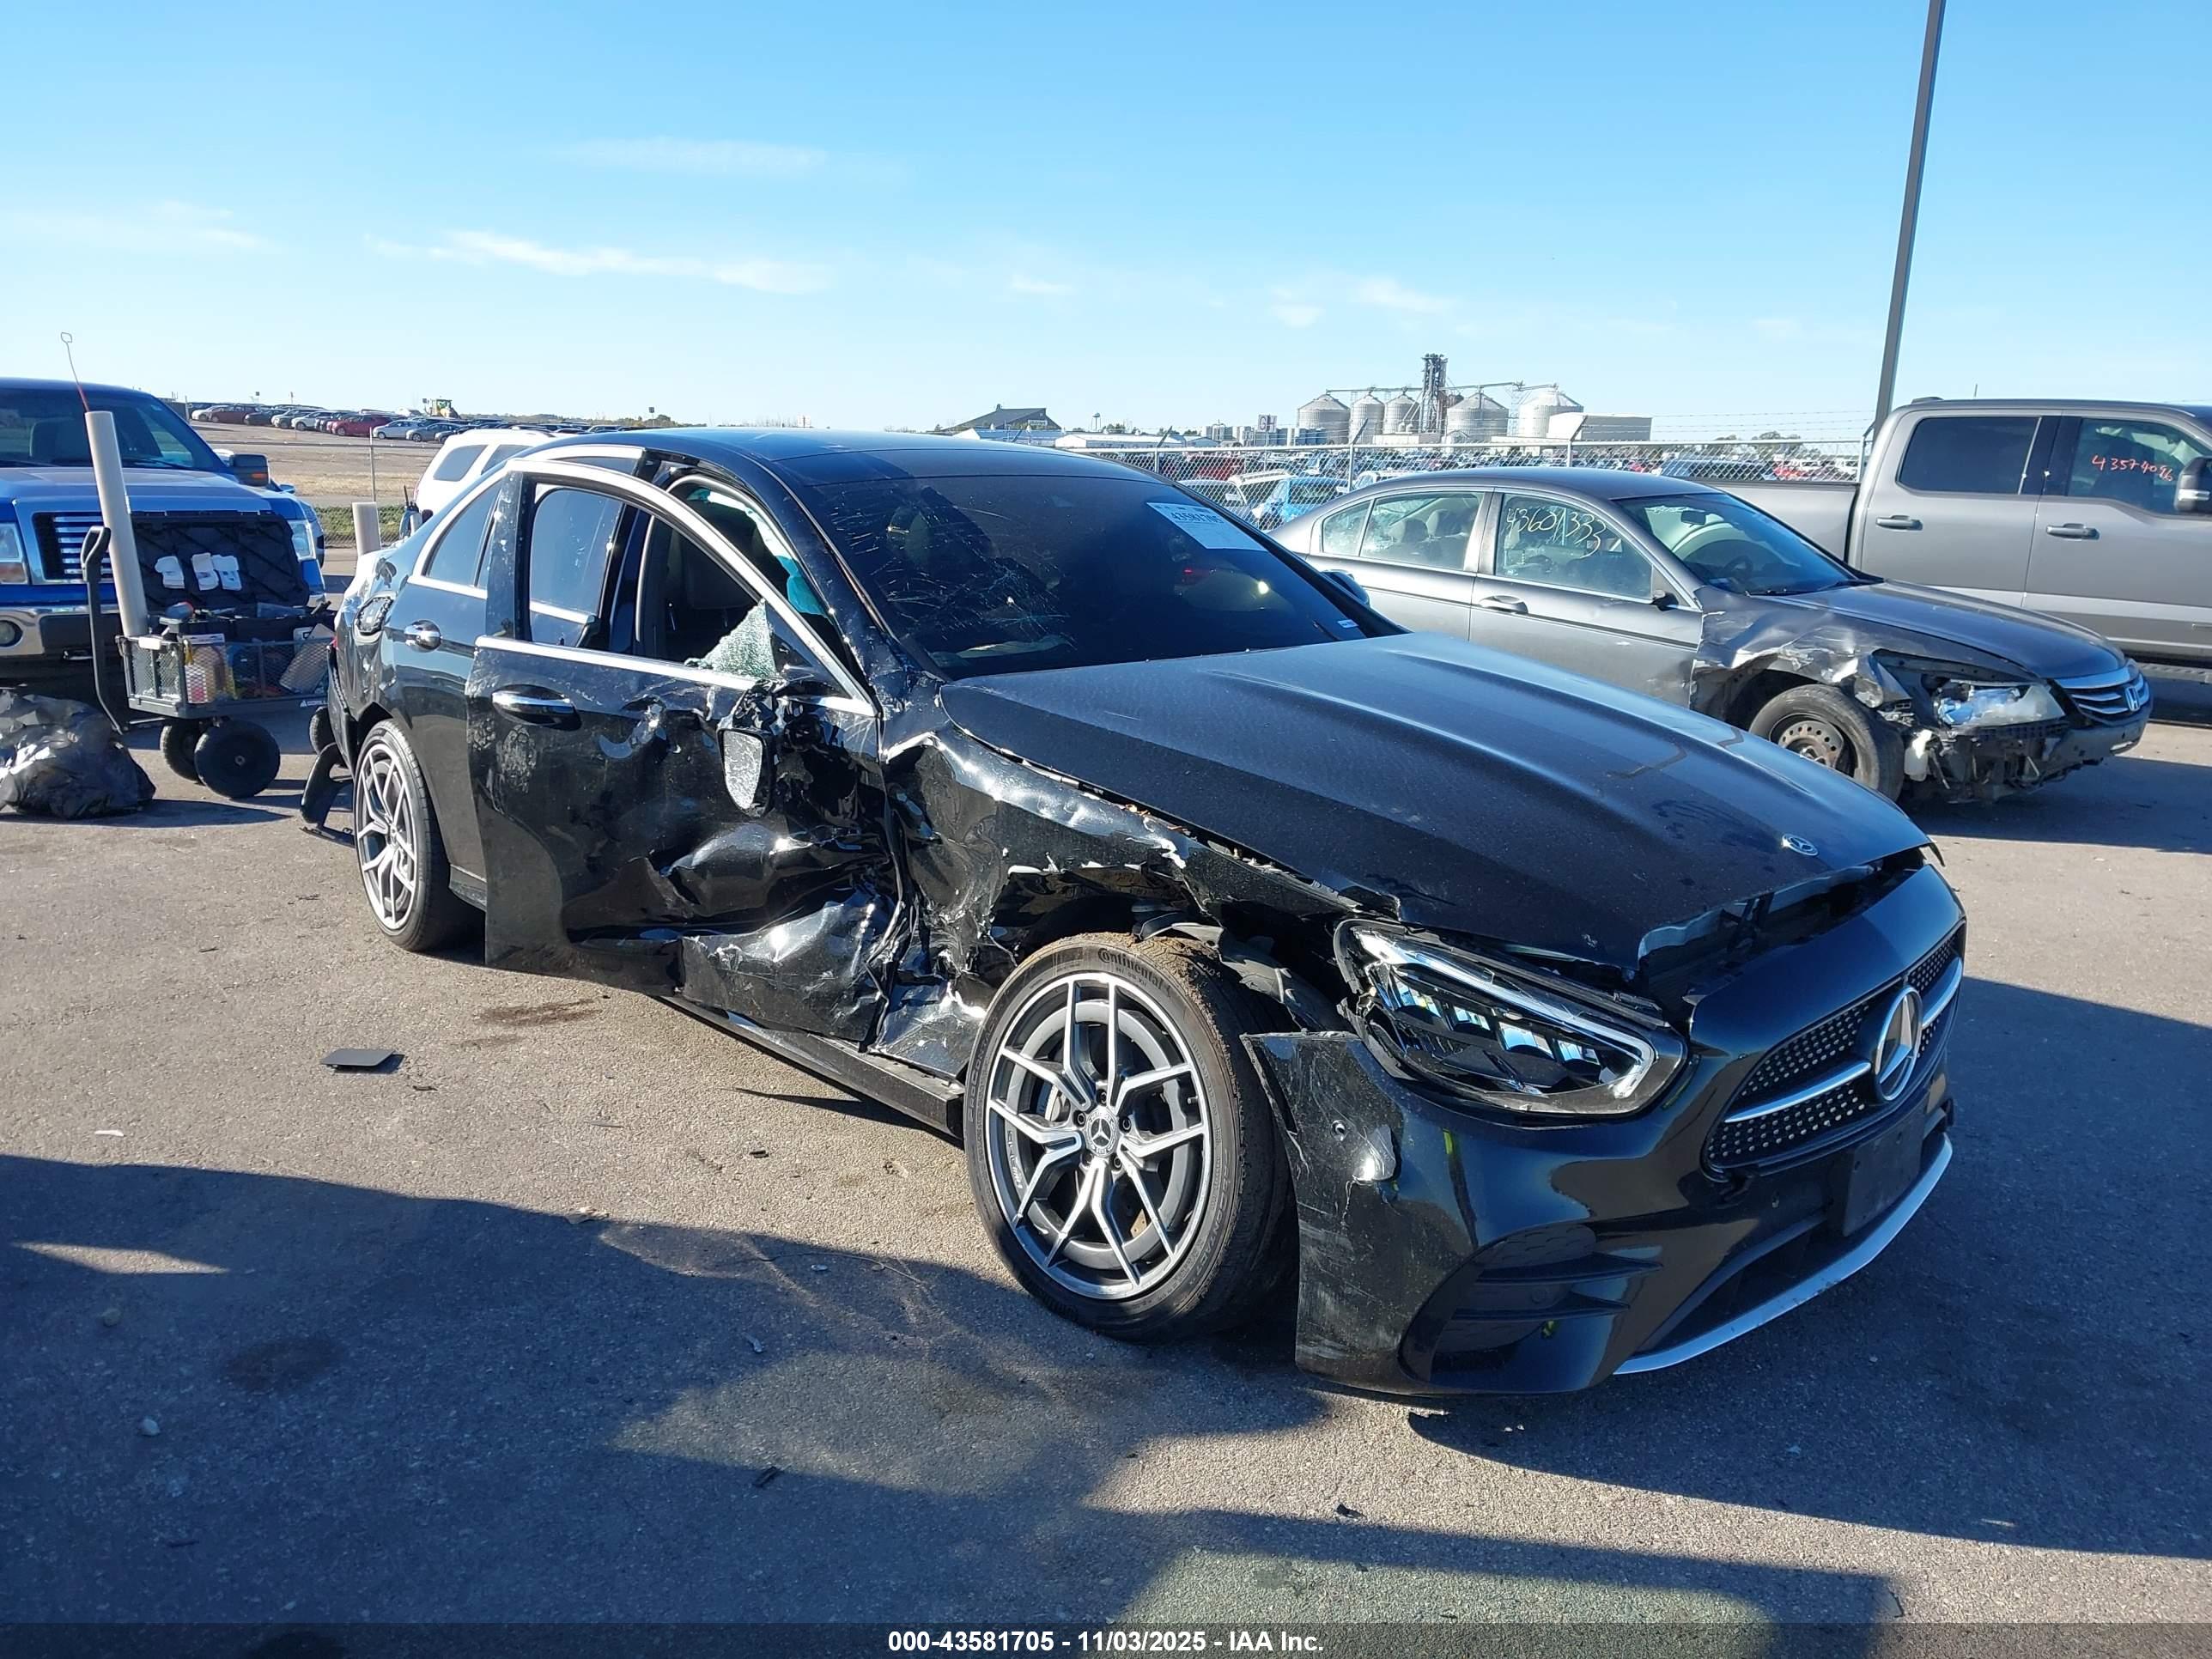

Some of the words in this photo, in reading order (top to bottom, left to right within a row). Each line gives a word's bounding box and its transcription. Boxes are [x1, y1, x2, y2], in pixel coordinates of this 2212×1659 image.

[1259, 415, 1276, 432] GH
[2092, 454, 2174, 482] 43574096
[1097, 947, 1166, 990] Continental
